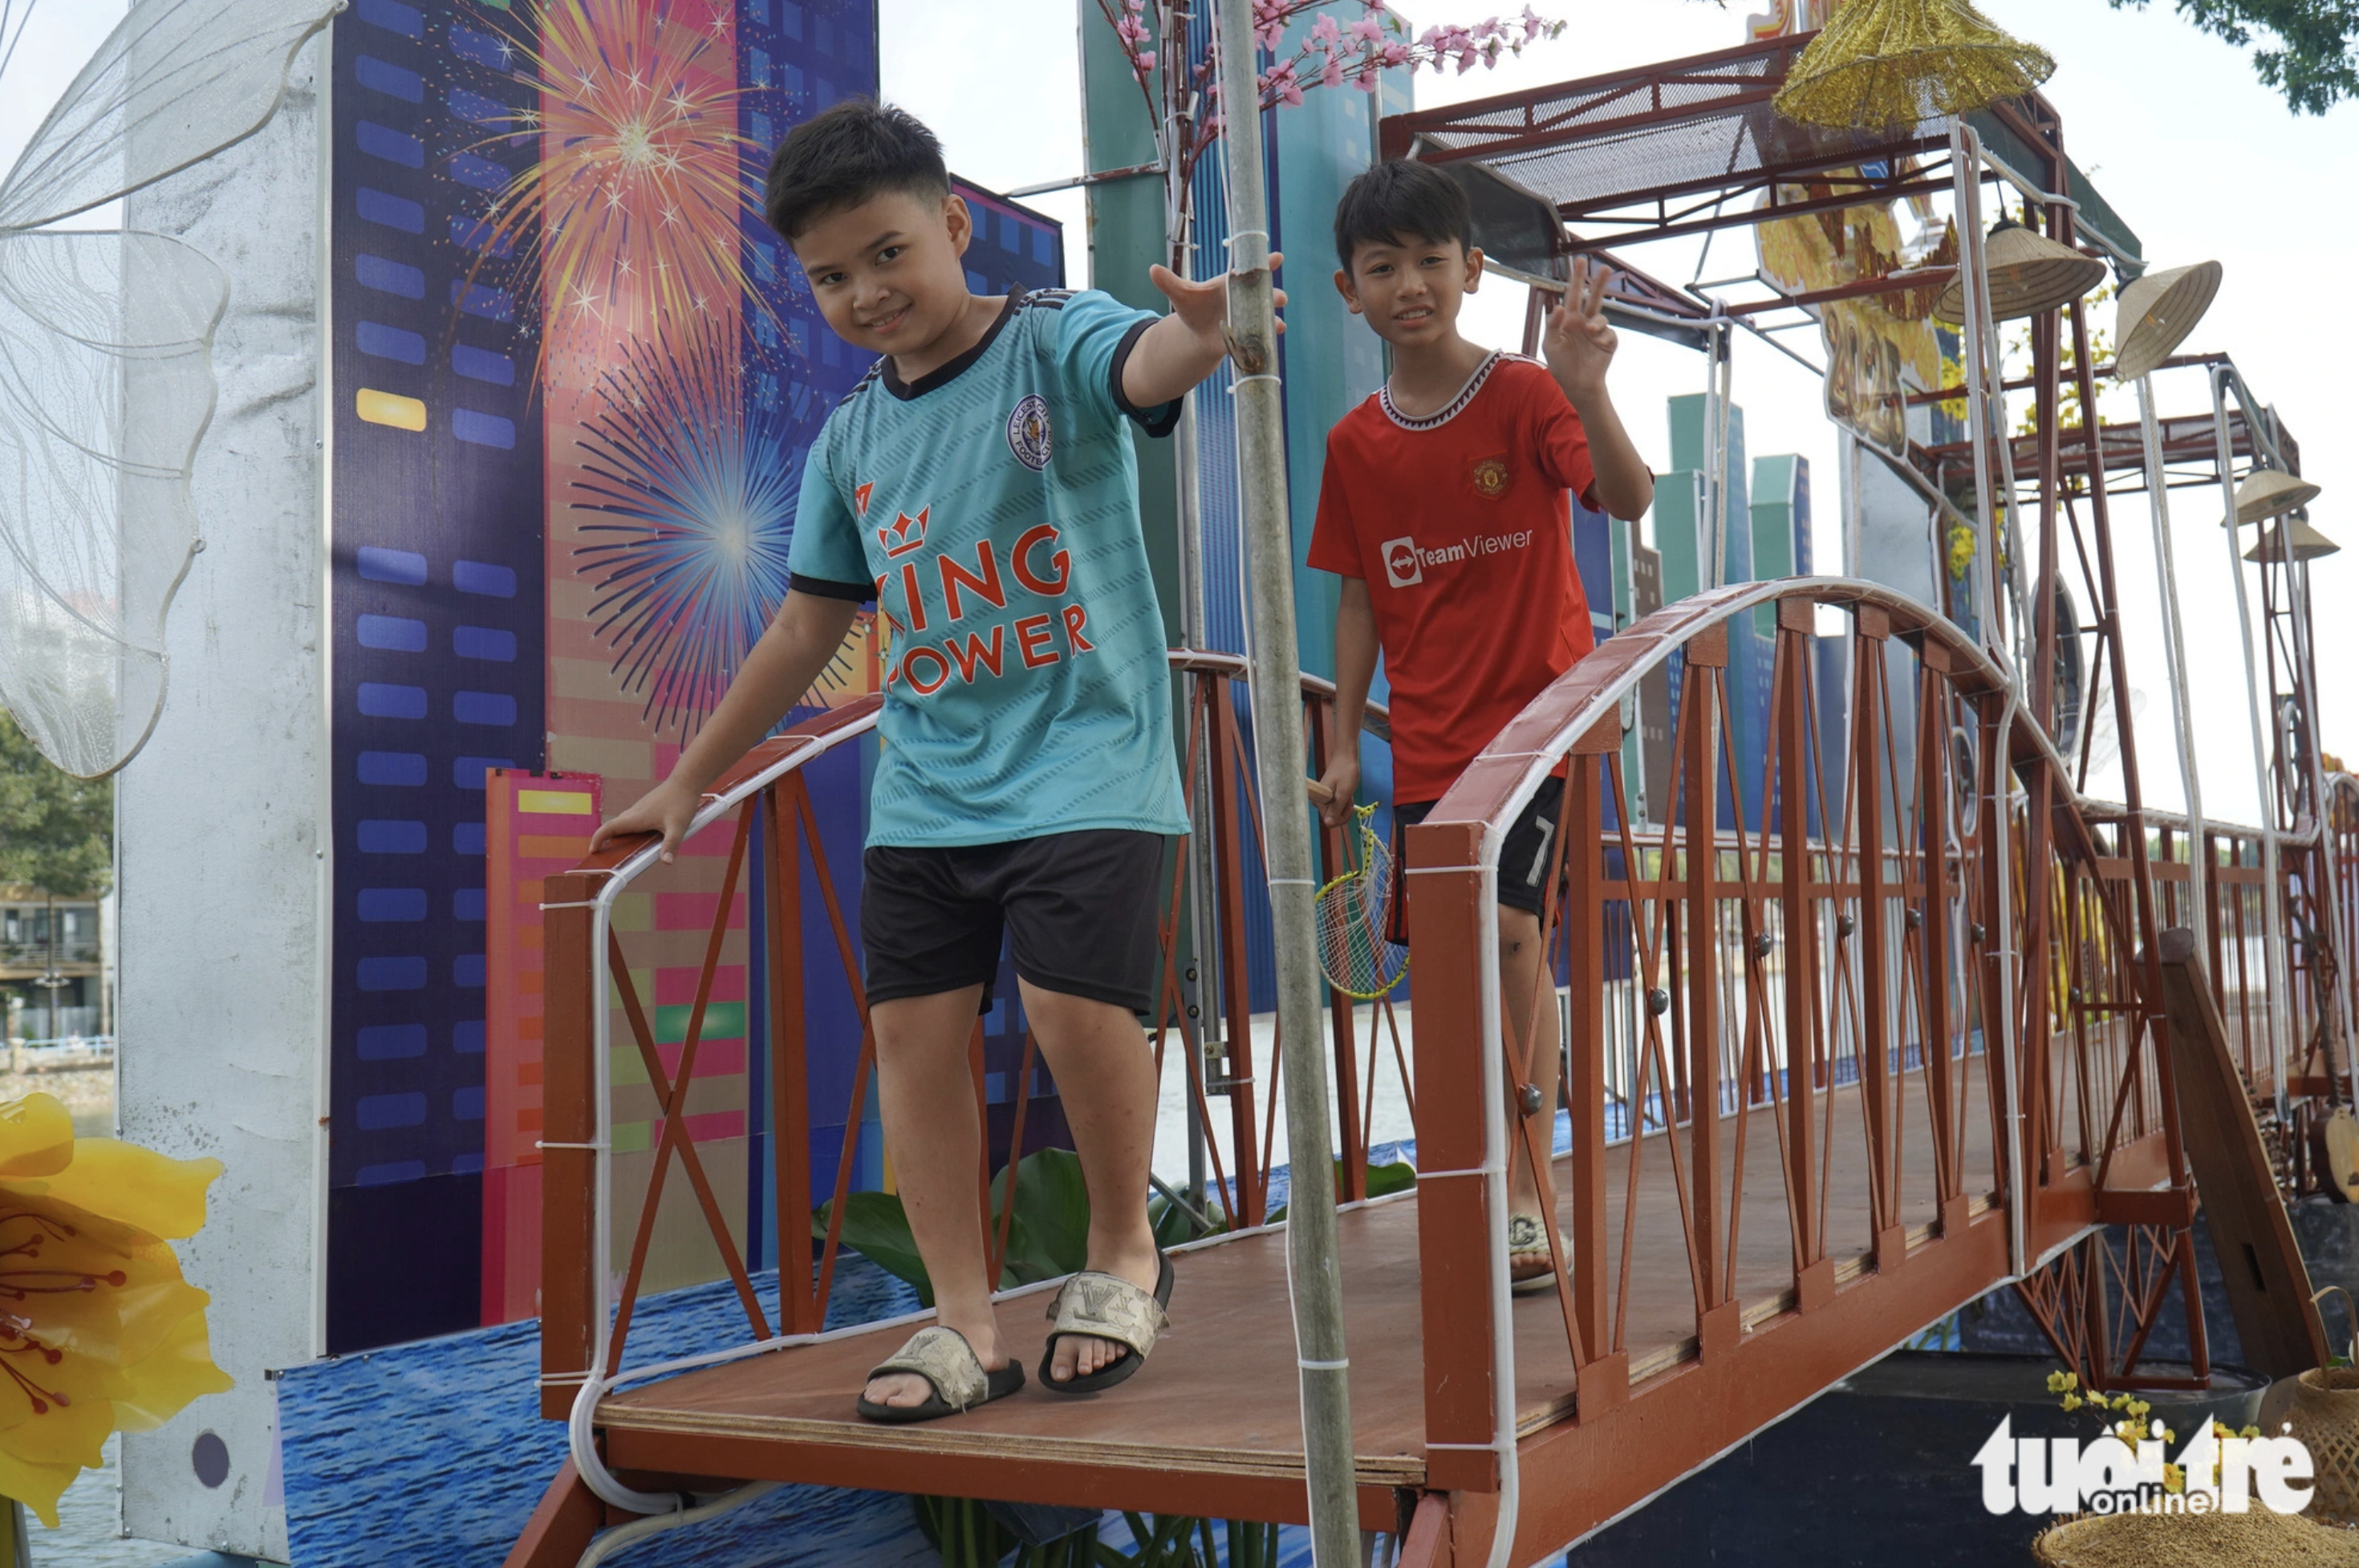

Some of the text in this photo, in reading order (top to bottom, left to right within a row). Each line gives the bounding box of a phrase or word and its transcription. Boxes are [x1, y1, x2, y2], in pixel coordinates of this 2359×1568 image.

[1013, 400, 1037, 436] LEICEST
[1015, 431, 1052, 465] FOOTB CLU
[1415, 530, 1533, 568] TeamViewer
